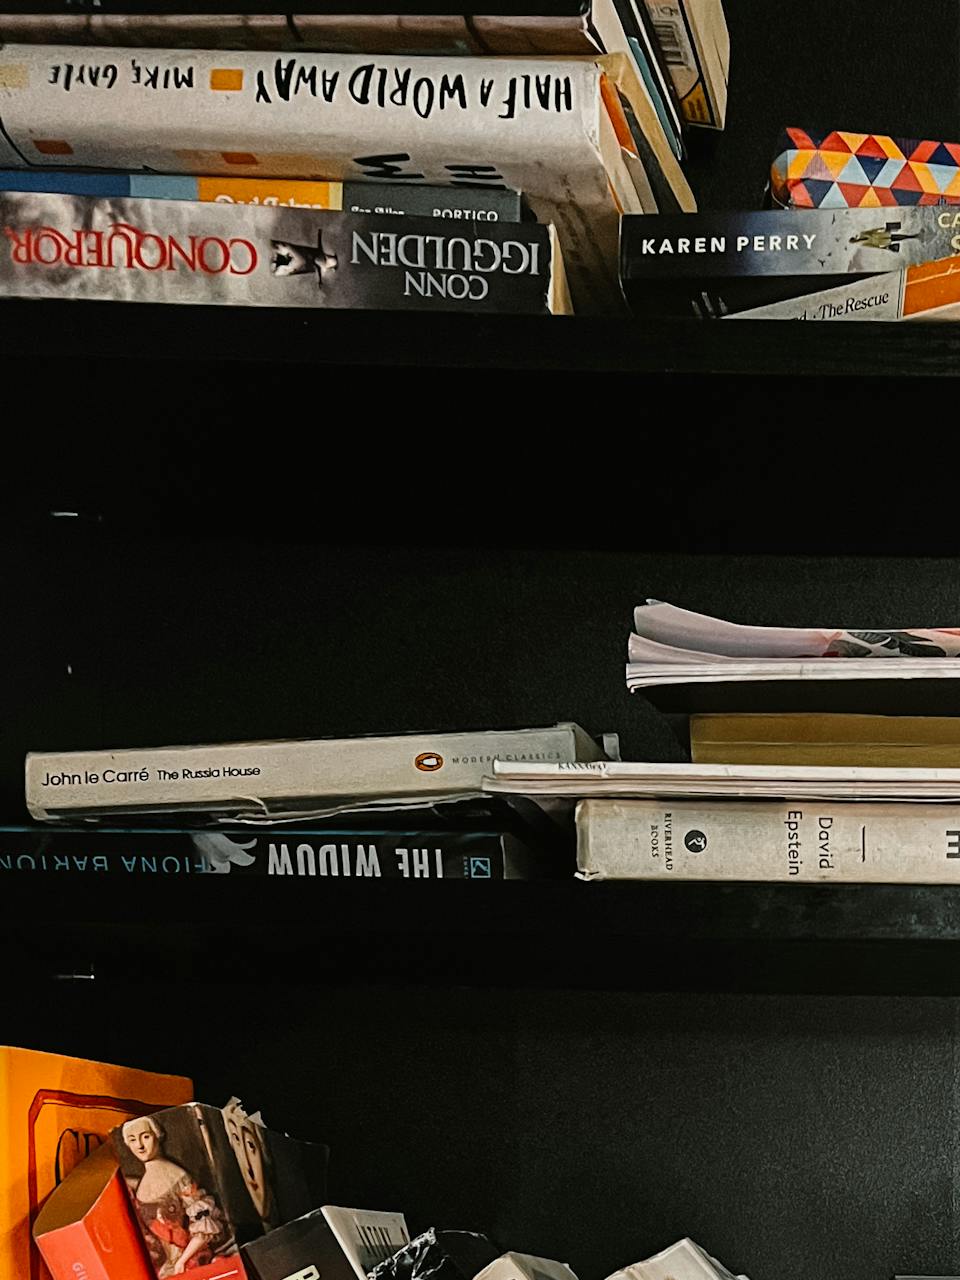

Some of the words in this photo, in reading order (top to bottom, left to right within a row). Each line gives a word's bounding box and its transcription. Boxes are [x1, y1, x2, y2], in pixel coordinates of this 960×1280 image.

[48, 64, 118, 90] GAYLE
[256, 57, 337, 103] AWAY
[349, 63, 468, 118] WORLD
[480, 79, 495, 109] A
[499, 74, 574, 118] HALF
[432, 208, 498, 222] PORTICO
[10, 225, 259, 277] CONQUEROR
[350, 231, 540, 277] IGGULDEN
[641, 236, 727, 255] KAREN
[736, 233, 817, 252] PERRY
[403, 271, 489, 300] CONN
[819, 303, 845, 320] The
[845, 291, 890, 314] Rescue
[41, 771, 82, 788] John
[84, 770, 98, 785] le
[102, 767, 150, 785] Carré
[157, 769, 180, 781] The
[182, 766, 220, 780] Russia
[222, 764, 261, 778] House
[650, 823, 660, 859] BOOKS
[663, 812, 673, 871] RIVERHEAD
[787, 810, 802, 876] Epstein
[817, 816, 833, 871] David
